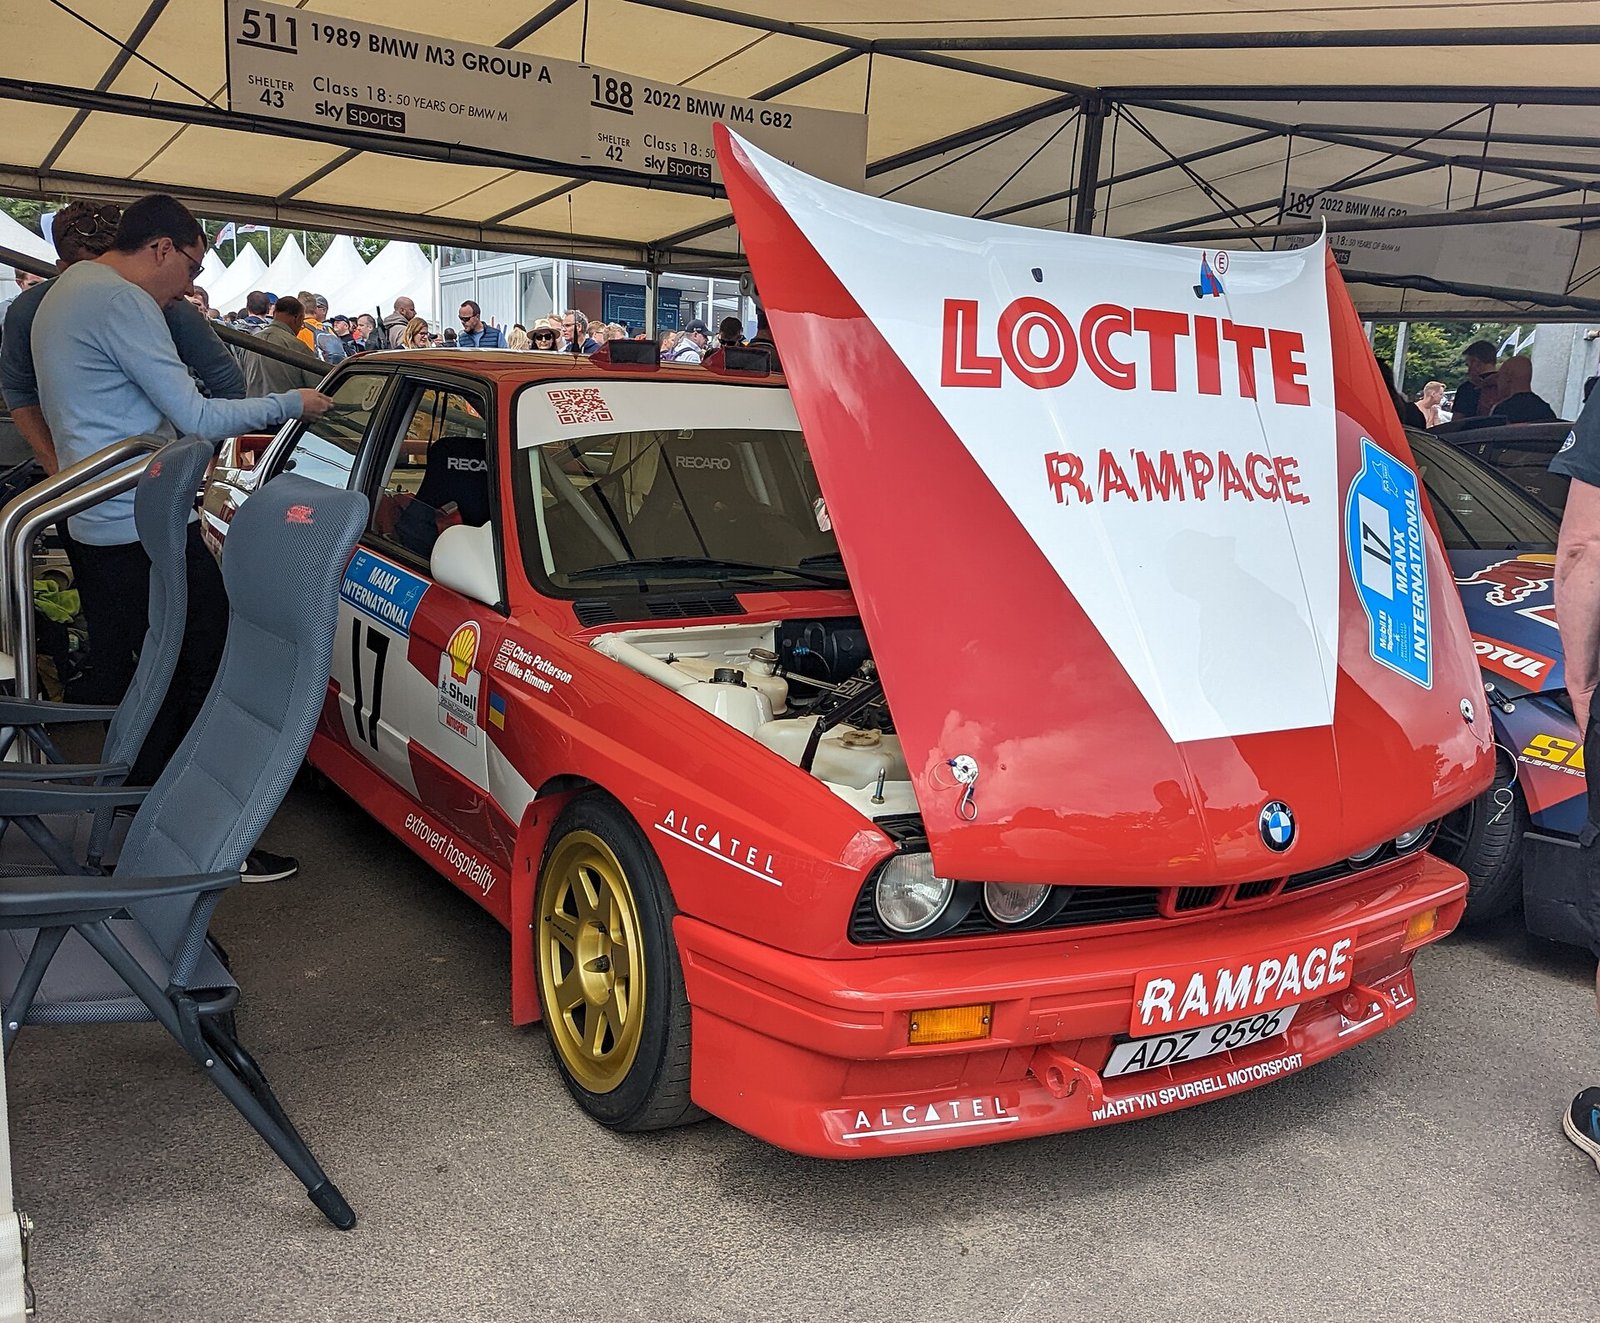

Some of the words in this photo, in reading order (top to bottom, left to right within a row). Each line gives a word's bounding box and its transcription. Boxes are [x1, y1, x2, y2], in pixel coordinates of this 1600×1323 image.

[242, 8, 297, 47] 511
[311, 22, 361, 49] 1989
[368, 33, 419, 60] BMW
[425, 44, 455, 67] M3
[462, 52, 532, 80] GROUP
[537, 65, 552, 84] A
[248, 74, 295, 92] SHELTER
[259, 88, 285, 109] 43
[312, 76, 358, 98] Class
[396, 94, 410, 106] 50
[413, 96, 446, 113] YEARS
[449, 102, 466, 115] OF
[467, 105, 495, 121] BMW
[497, 111, 508, 122] M
[592, 73, 633, 108] 188
[314, 100, 344, 122] sky
[349, 108, 403, 129] sports
[643, 87, 681, 111] 2022
[686, 96, 725, 119] BMW
[729, 104, 755, 124] M4
[759, 110, 792, 129] G82
[597, 132, 631, 148] SHELTER
[605, 144, 623, 162] 42
[643, 134, 677, 153] Class
[644, 154, 666, 173] sky
[669, 162, 710, 178] sports
[1290, 192, 1315, 214] 189
[1319, 197, 1344, 213] 2022
[1345, 201, 1370, 216] BMW
[1370, 205, 1386, 218] M4
[940, 296, 1312, 408] LOCTITE
[447, 457, 488, 471] RECA
[675, 455, 731, 470] RECARO
[1044, 447, 1311, 507] RAMPAGE
[1362, 521, 1392, 566] 17
[1392, 526, 1409, 595] MANX
[367, 566, 401, 595] MANX
[1404, 488, 1427, 663] INTERNATIONAL
[341, 578, 409, 629] INTERNATIONAL
[505, 660, 523, 679] Mike
[522, 668, 554, 694] Rimmer
[512, 645, 534, 665] Chris
[531, 654, 573, 685] Patterson
[1472, 639, 1547, 679] OTUL
[352, 616, 391, 752] 17
[449, 682, 477, 712] Shell
[1517, 755, 1585, 778] SUSPENSIO
[1263, 803, 1293, 821] BMW
[404, 810, 448, 859] extrovert
[443, 838, 498, 897] hospitality
[663, 809, 775, 875] ALCATEL
[1140, 938, 1351, 1026] RAMPAGE
[1120, 1030, 1201, 1073] ADZ
[1207, 1008, 1285, 1054] 9596
[1091, 1093, 1158, 1121] MARTYN
[1159, 1074, 1227, 1105] SPURRELL
[1227, 1053, 1304, 1087] MOTORSPORT
[855, 1098, 1008, 1130] ALCATEL
